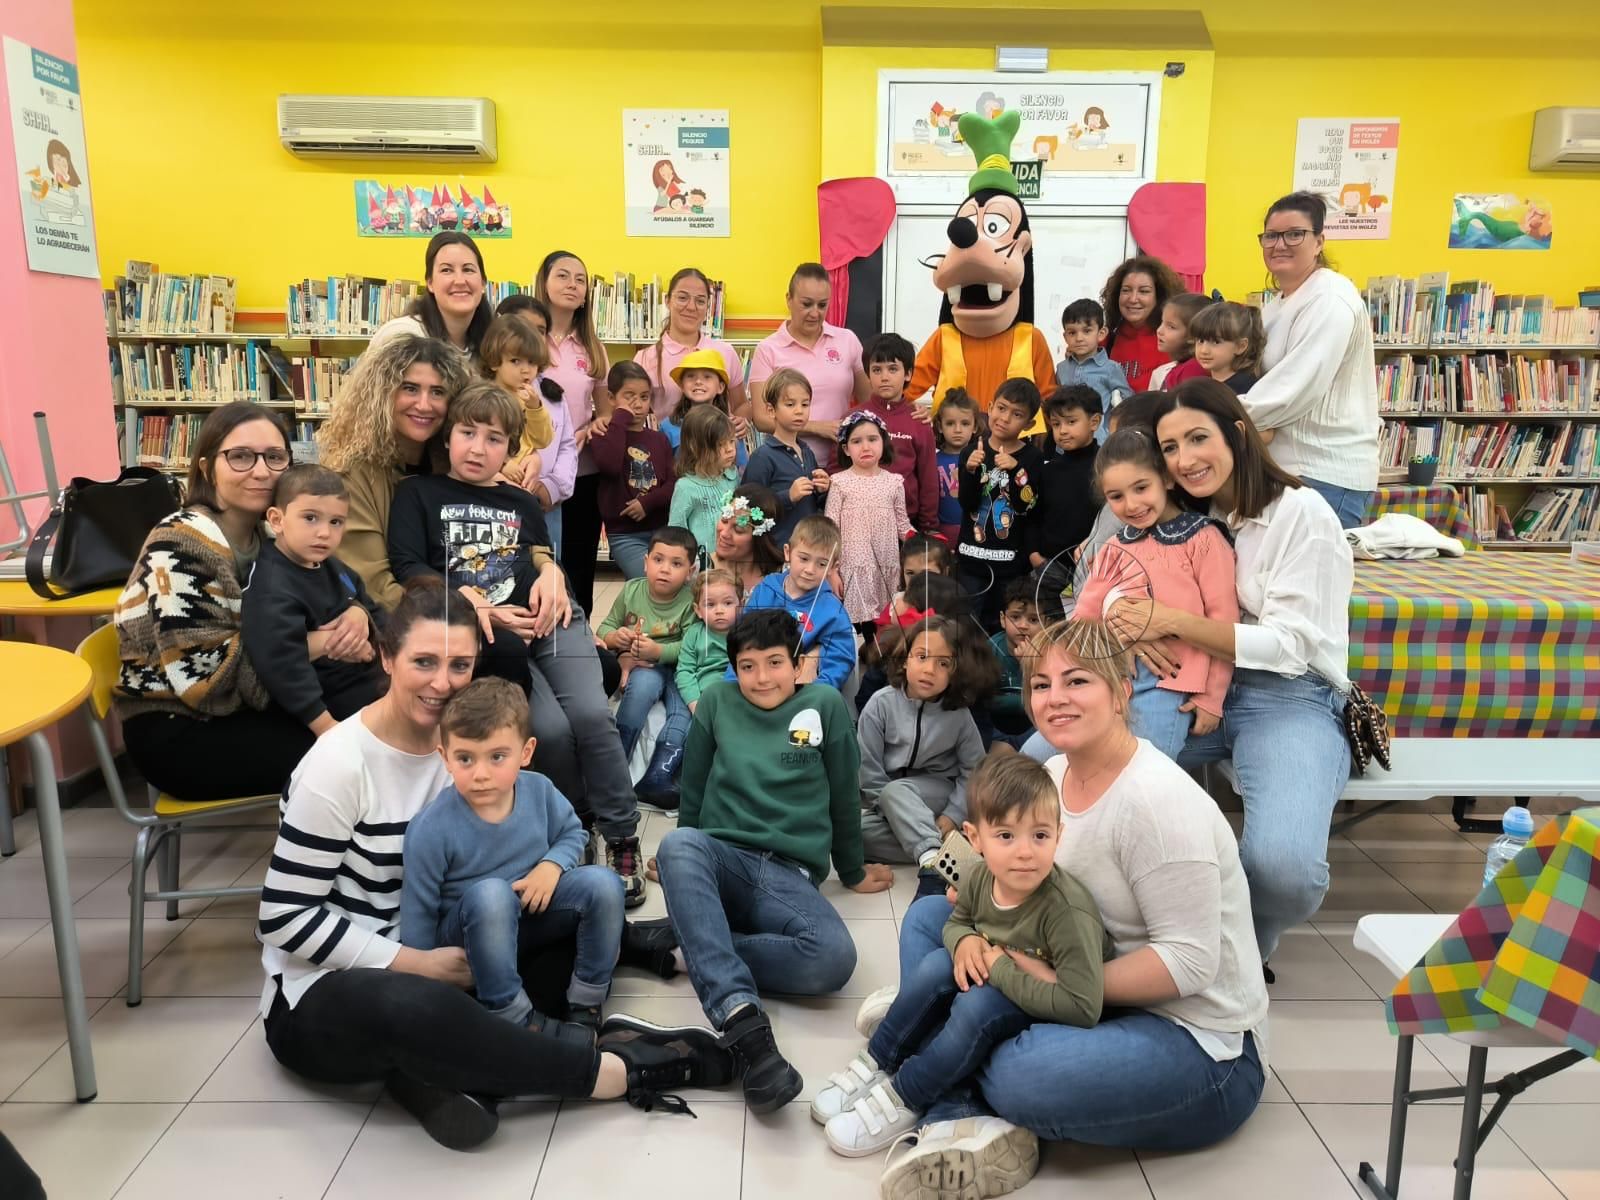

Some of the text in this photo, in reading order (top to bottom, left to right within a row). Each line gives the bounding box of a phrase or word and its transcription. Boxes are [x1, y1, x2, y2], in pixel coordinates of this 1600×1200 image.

[34, 54, 64, 72] SILENCIO
[36, 66, 70, 85] POR FAVOR
[1020, 94, 1065, 107] SILENCIO
[1036, 109, 1068, 121] FAVOR
[36, 225, 49, 235] LOS
[70, 232, 79, 241] TE
[37, 237, 46, 246] LO
[440, 503, 516, 523] NEW YORK CITY
[780, 751, 819, 765] PEANUTS
